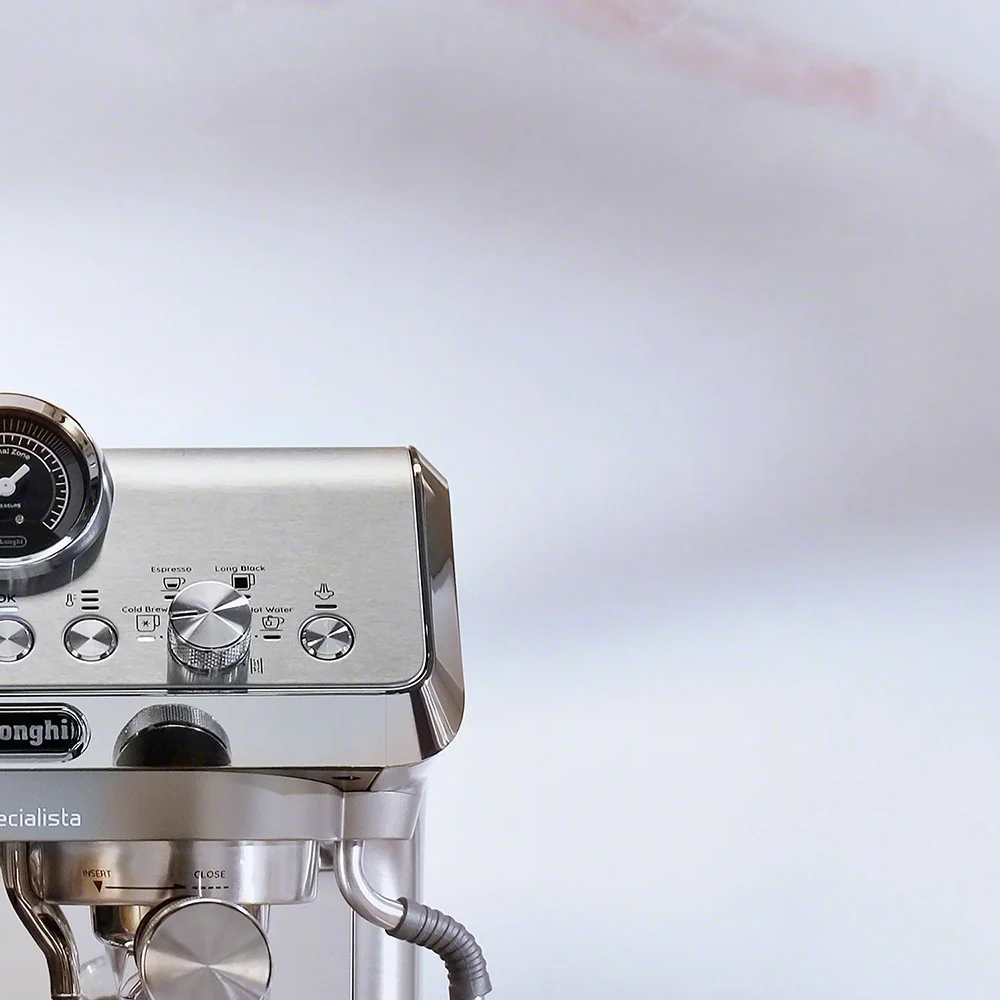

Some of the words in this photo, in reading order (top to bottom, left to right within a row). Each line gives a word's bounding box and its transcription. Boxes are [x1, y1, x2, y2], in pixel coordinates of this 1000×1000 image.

[11, 449, 31, 460] Zone
[214, 565, 238, 573] Long
[82, 870, 111, 878] INSERT
[194, 870, 226, 879] CLOSE
